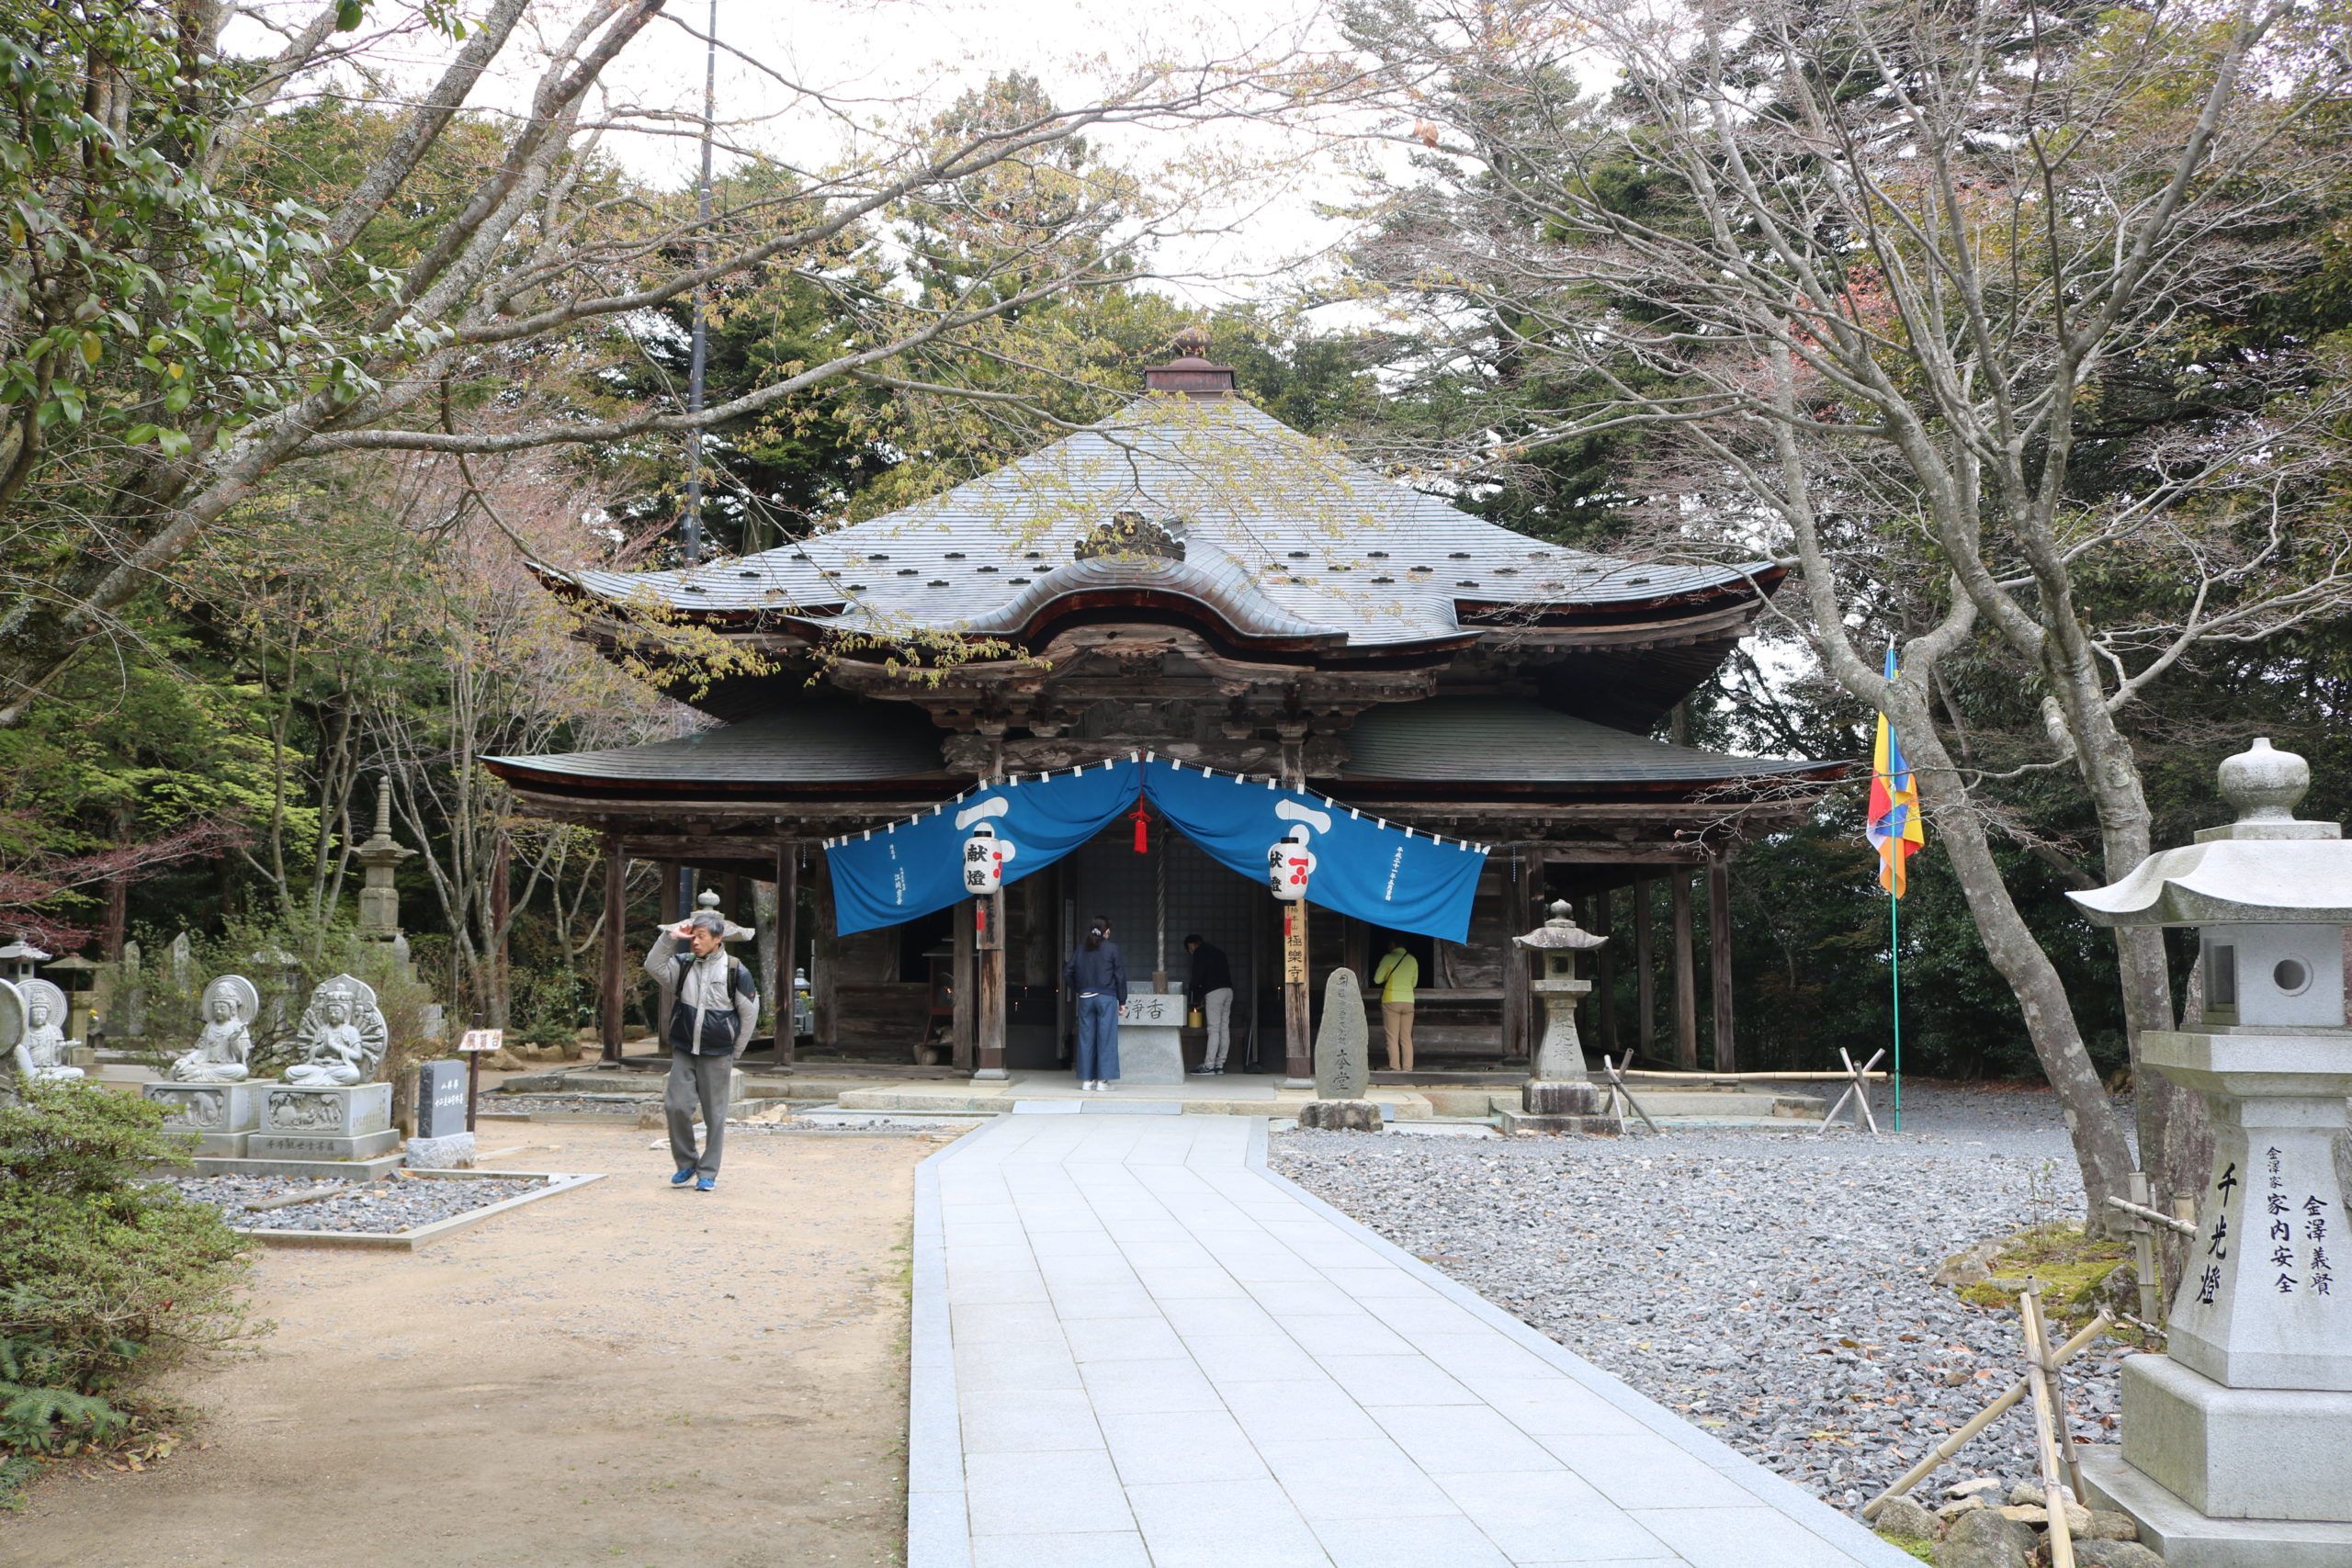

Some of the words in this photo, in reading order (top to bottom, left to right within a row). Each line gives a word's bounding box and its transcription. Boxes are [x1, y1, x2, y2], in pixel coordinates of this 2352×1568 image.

[967, 844, 988, 886] 献燈
[2196, 1162, 2237, 1304] 千光燈
